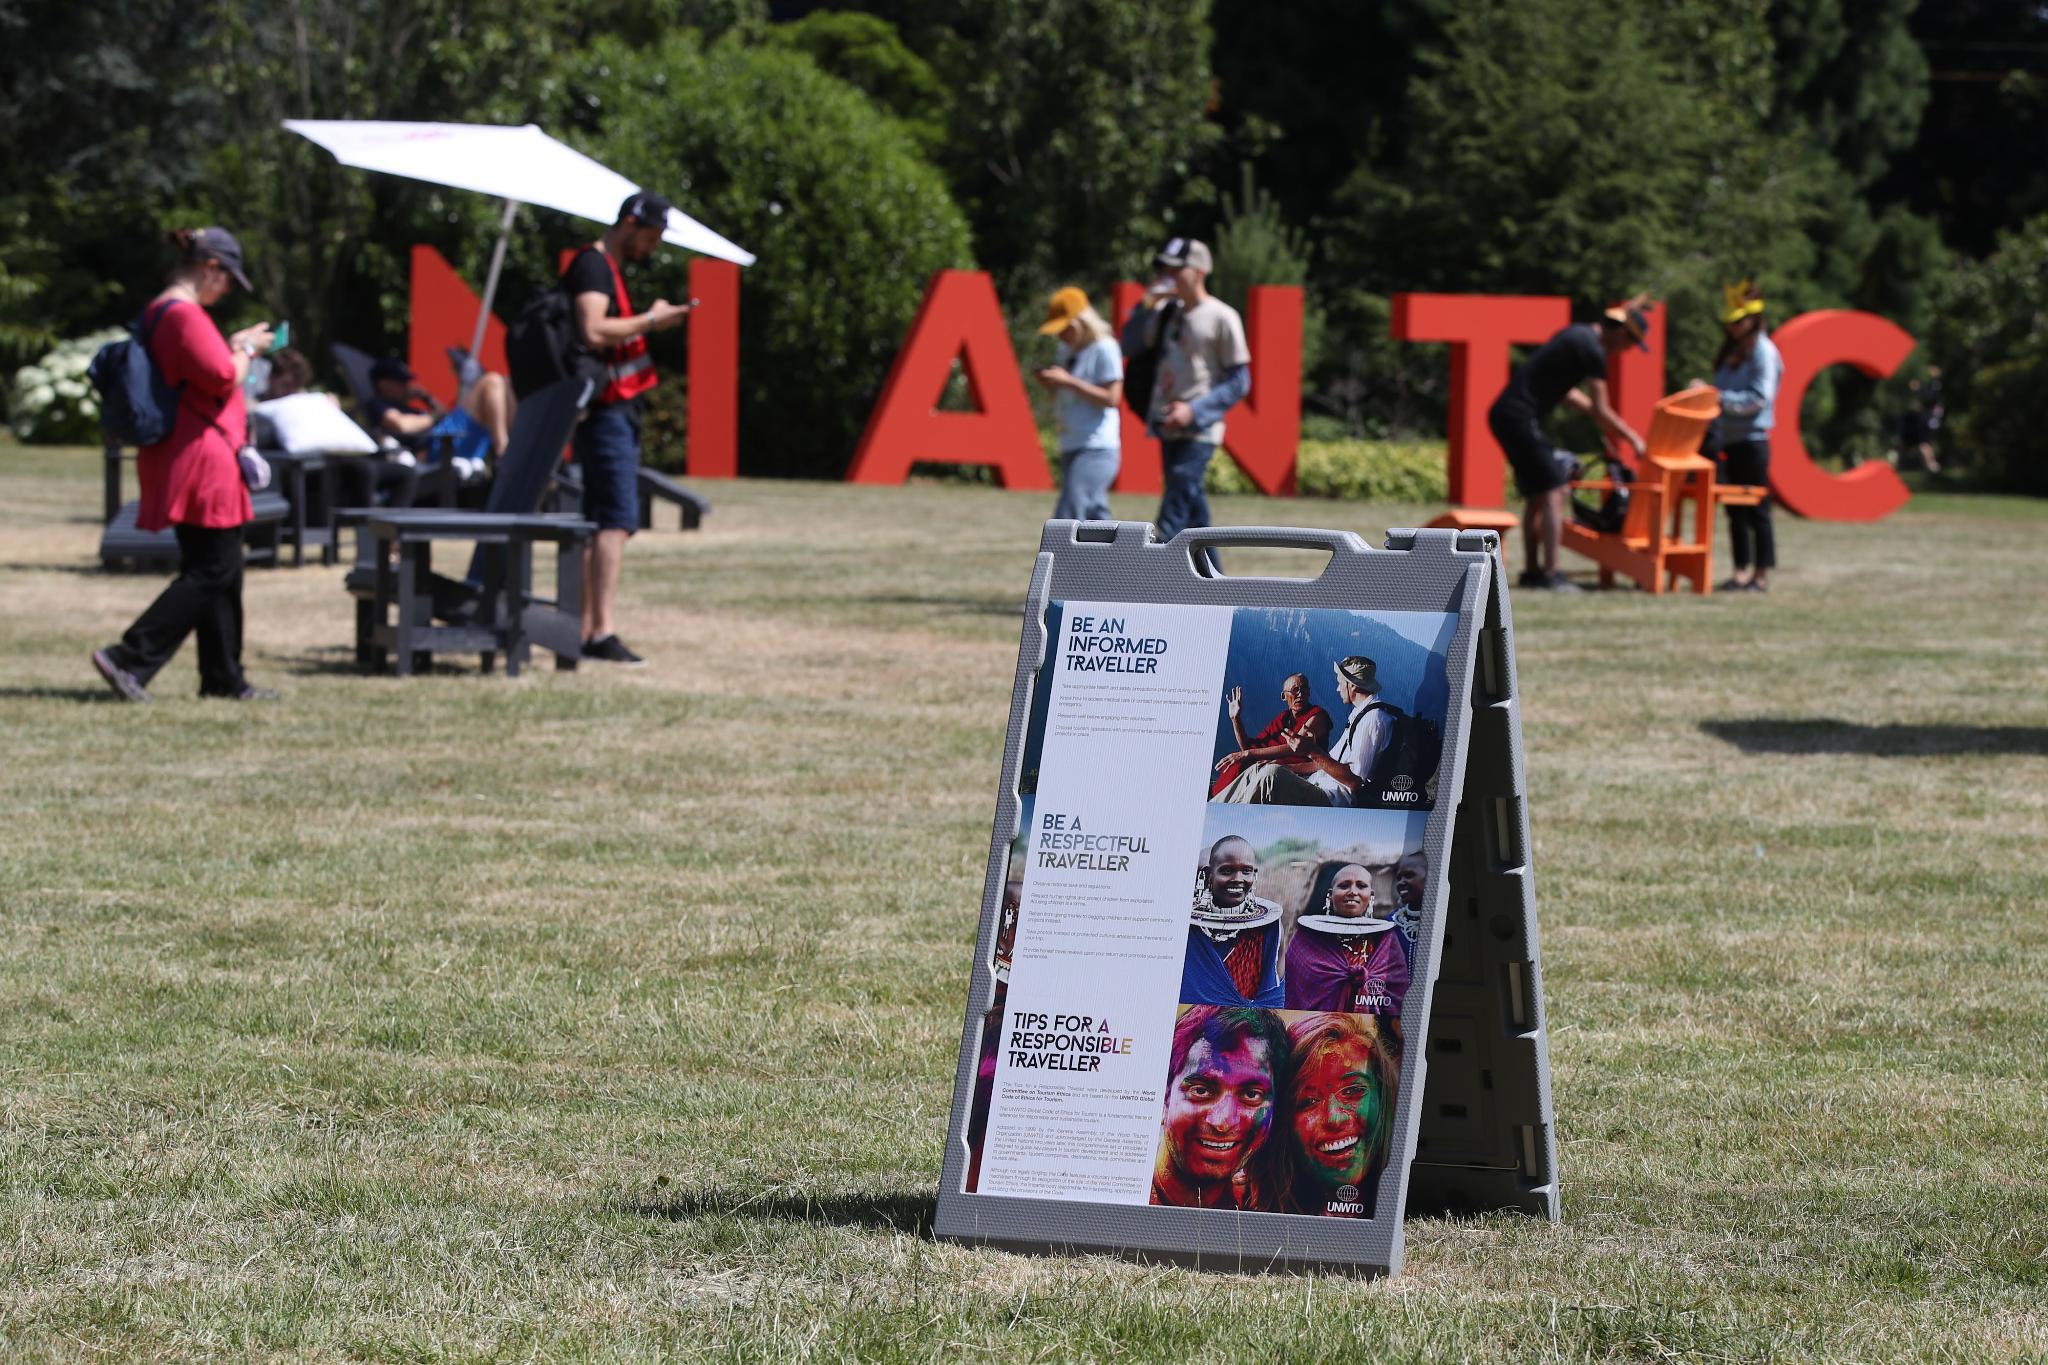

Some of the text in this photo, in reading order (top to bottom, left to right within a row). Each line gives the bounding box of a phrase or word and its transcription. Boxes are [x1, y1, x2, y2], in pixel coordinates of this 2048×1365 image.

[1071, 616, 1125, 634] BE AN
[1068, 635, 1168, 655] INFORMED
[1066, 655, 1158, 674] TRAVELLER
[1382, 791, 1419, 802] UNWTO
[1043, 814, 1082, 831] BE A
[1040, 833, 1150, 853] RESPECTFUL
[1037, 852, 1130, 872] TRAVELLER
[1355, 994, 1392, 1007] UNWTO
[1013, 1012, 1110, 1034] TIPS FOR A
[1010, 1031, 1133, 1055] RESPONSIBLE
[1008, 1051, 1101, 1072] TRAVELLER
[1327, 1201, 1364, 1214] UNWTO
